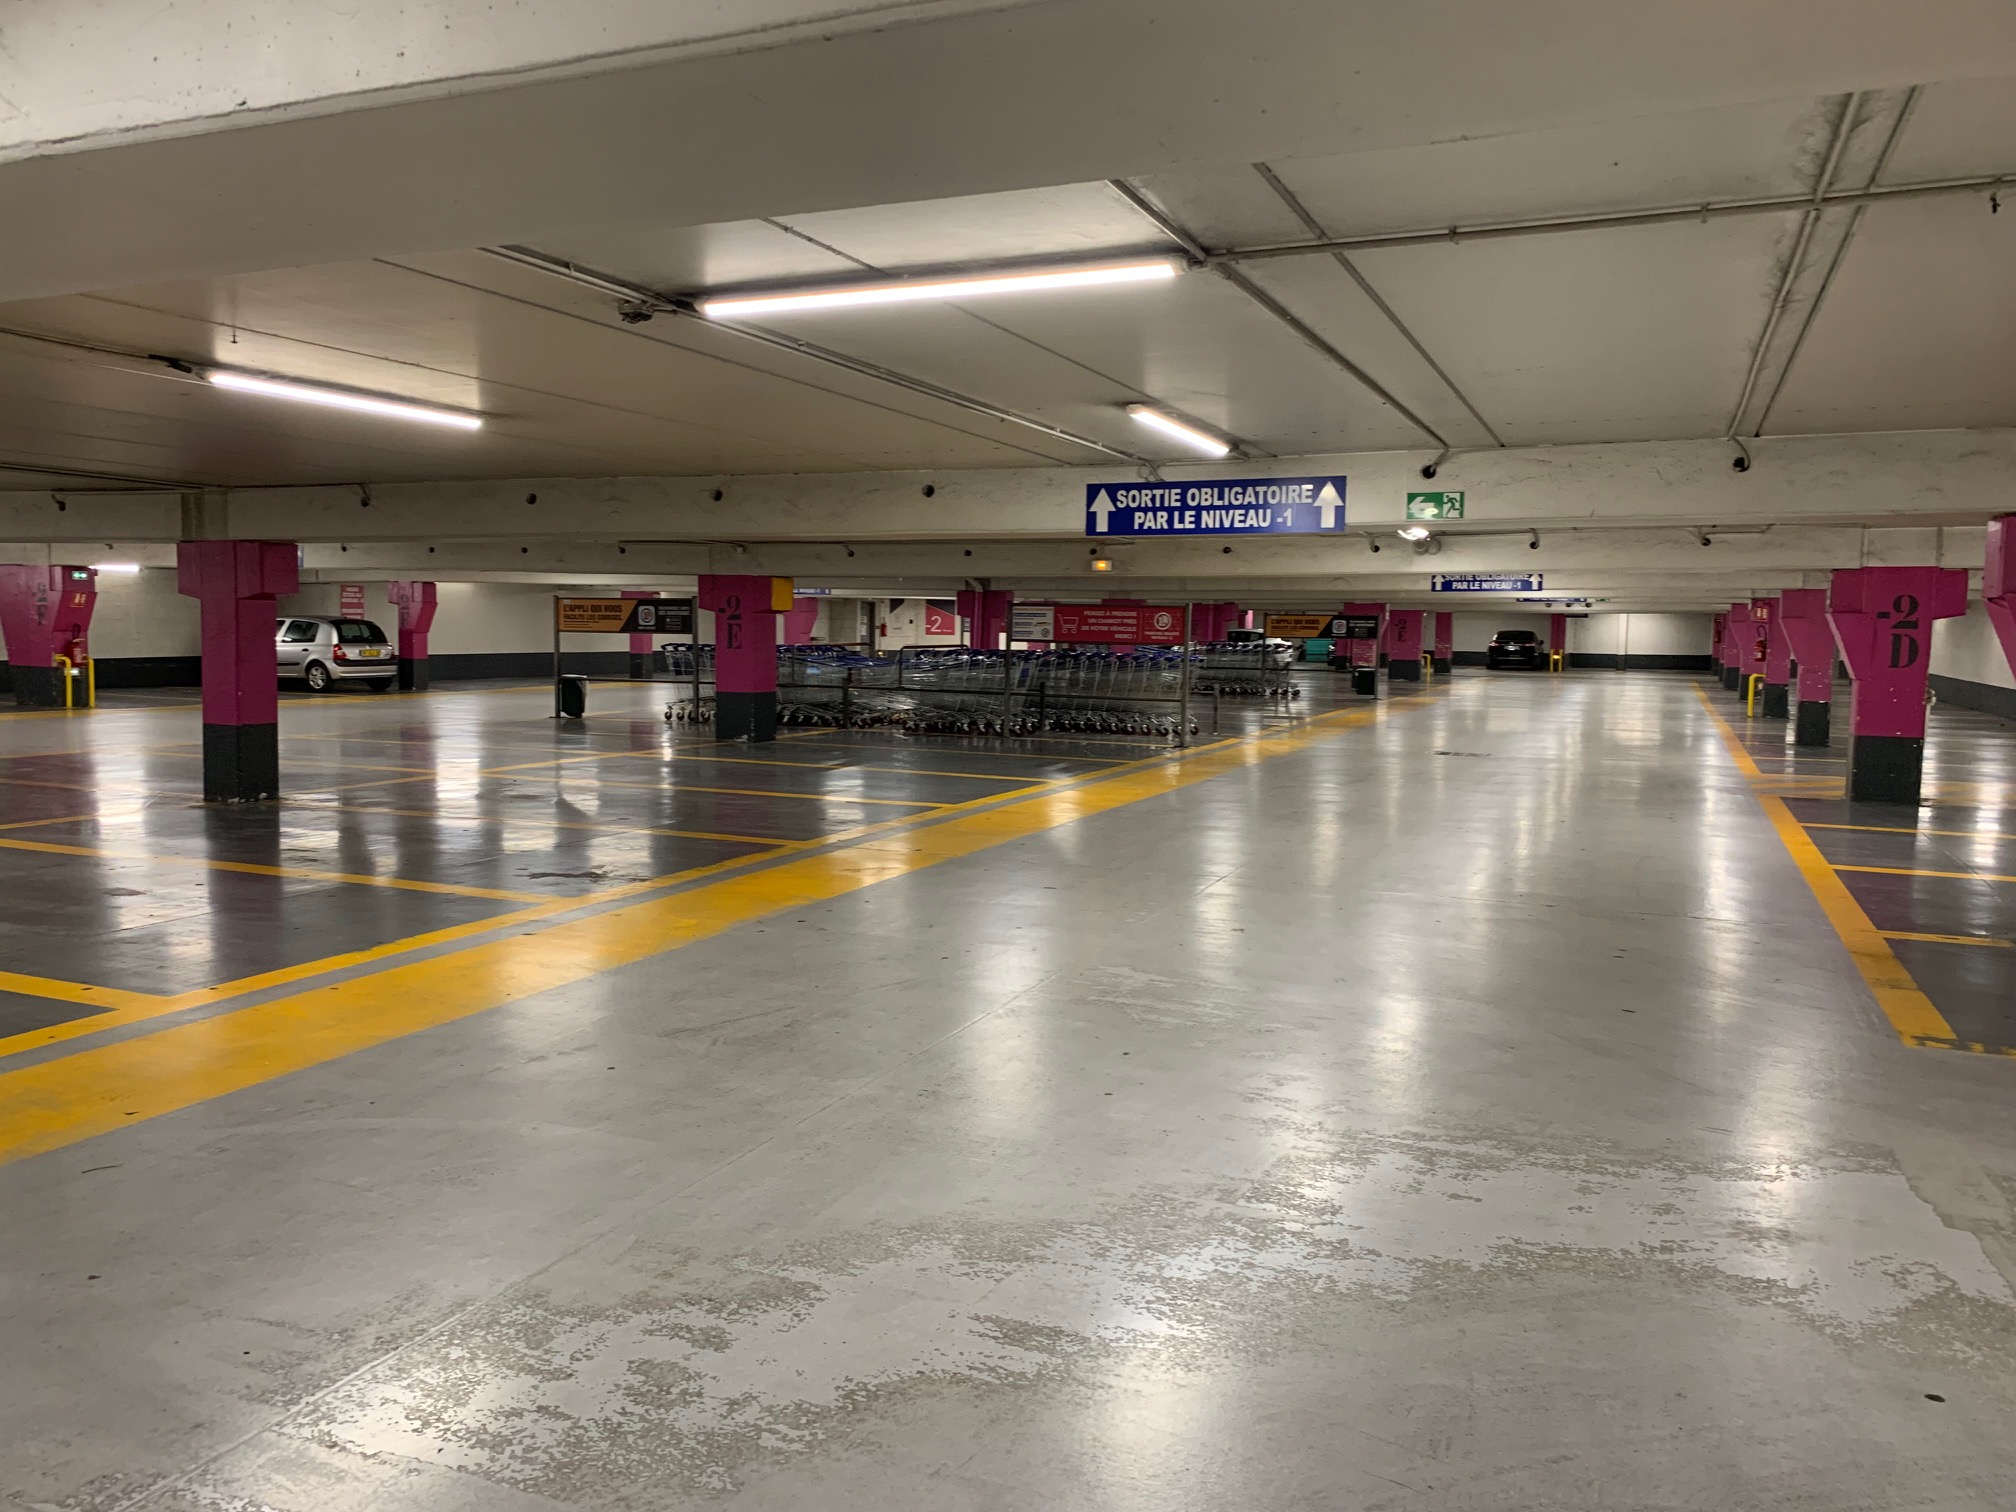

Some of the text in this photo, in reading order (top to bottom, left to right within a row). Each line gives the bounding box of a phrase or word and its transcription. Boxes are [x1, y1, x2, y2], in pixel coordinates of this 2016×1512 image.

[1116, 484, 1314, 508] SORTIE OBLIGATOIRE
[1133, 508, 1292, 530] PAR LE NIVEAU -1
[1452, 581, 1522, 590] PAR LE NIVEAU -1
[718, 594, 742, 621] -2
[1877, 594, 1919, 630] -2
[925, 615, 942, 632] -2
[726, 623, 742, 650] E
[1888, 633, 1919, 668] D
